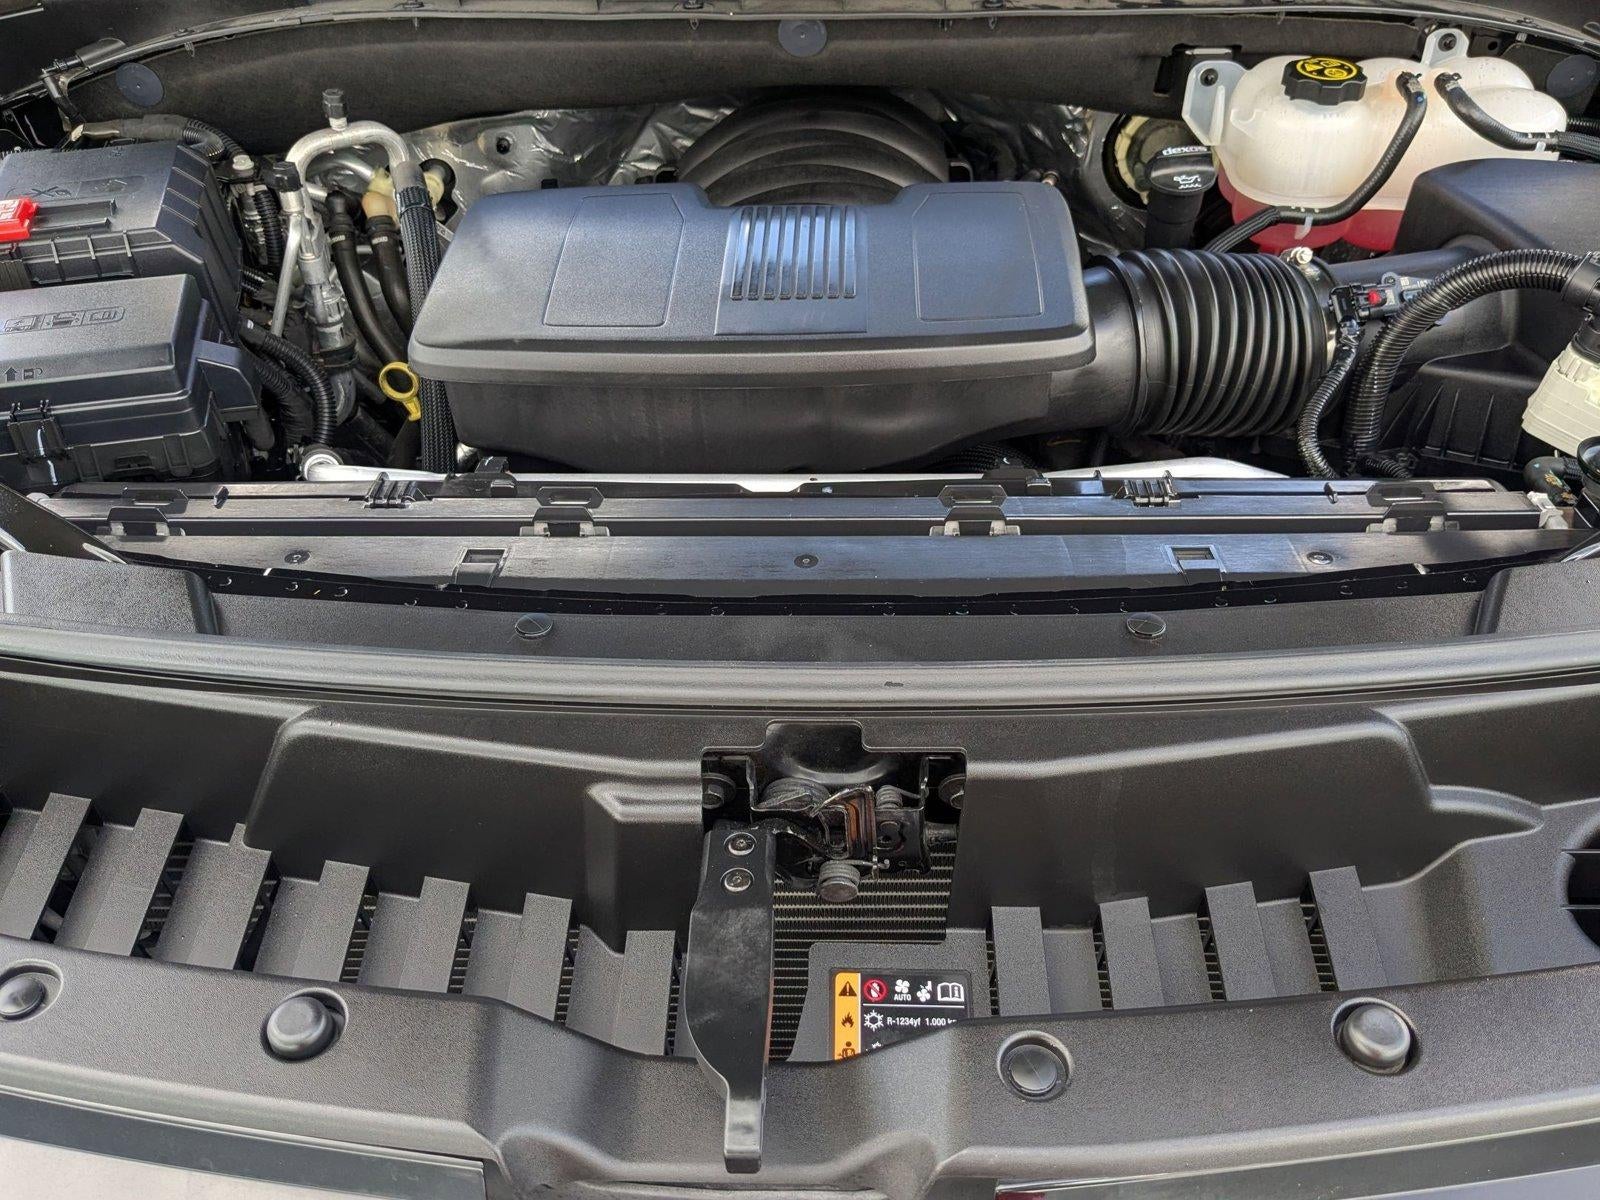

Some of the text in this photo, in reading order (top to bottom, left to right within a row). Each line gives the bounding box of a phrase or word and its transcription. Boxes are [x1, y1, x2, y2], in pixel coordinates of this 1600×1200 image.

[1162, 146, 1207, 156] dexos
[886, 1016, 921, 1027] R-1234yf
[925, 1017, 947, 1026] 1.000
